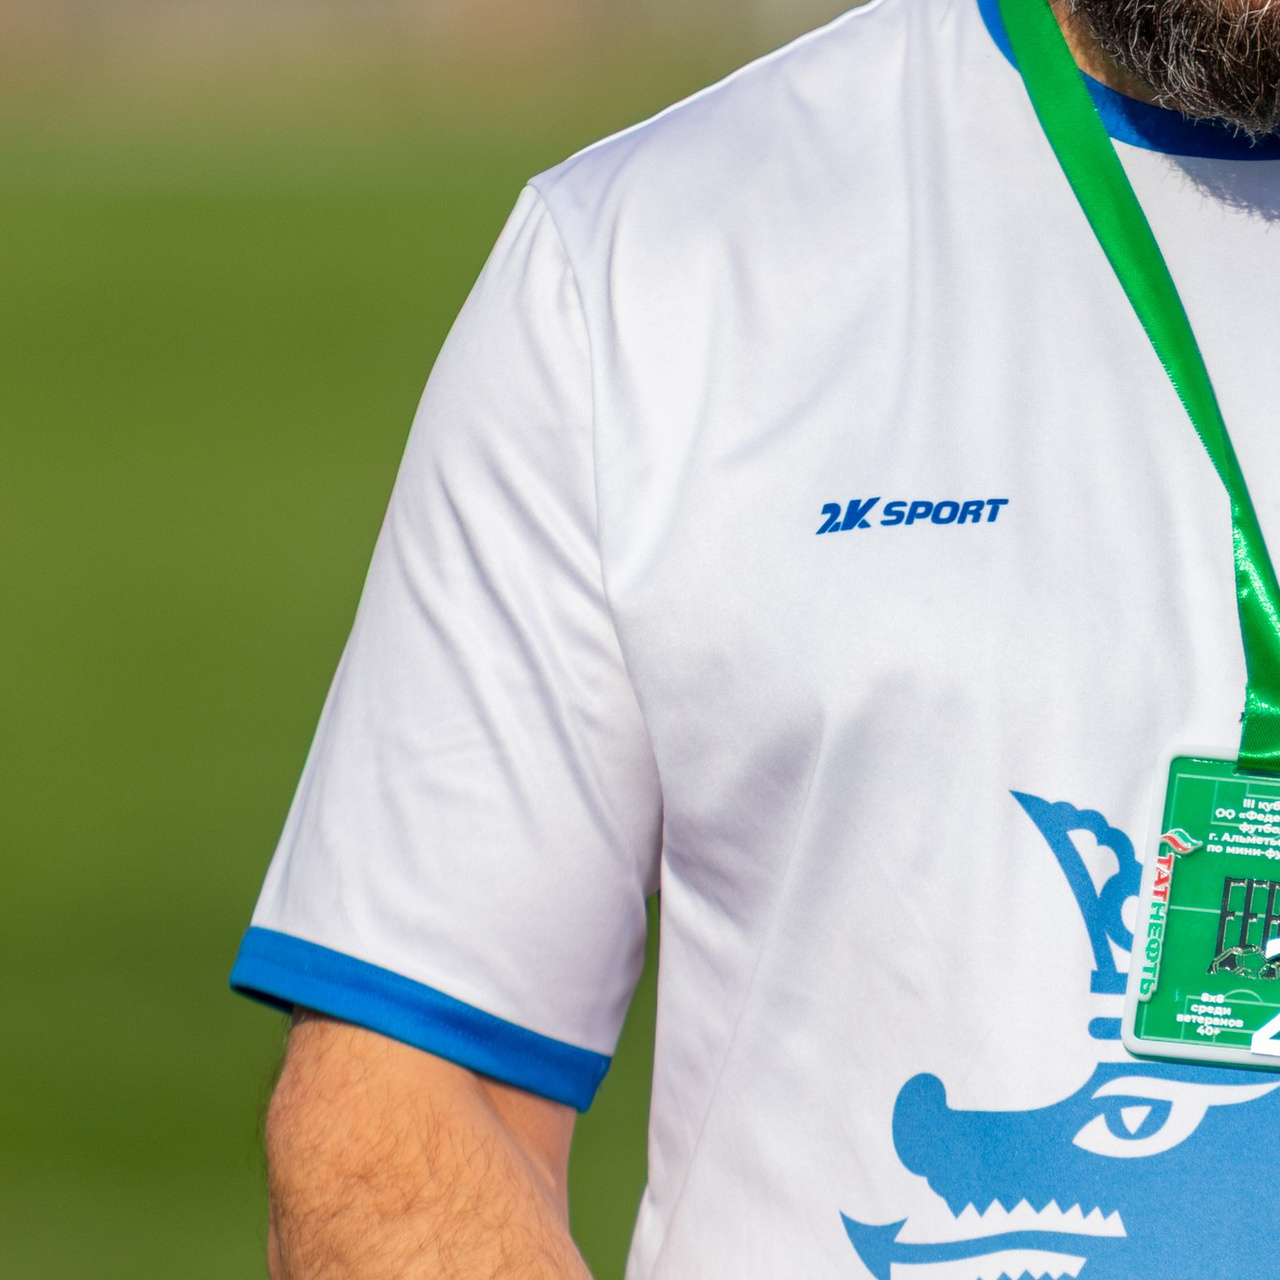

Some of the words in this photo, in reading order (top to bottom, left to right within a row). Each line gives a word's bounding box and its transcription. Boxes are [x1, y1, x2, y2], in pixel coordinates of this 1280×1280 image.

[815, 497, 881, 535] 2K
[880, 498, 1009, 526] SPORT
[1206, 844, 1223, 853] по
[1140, 854, 1174, 996] ТАТНЕФТЬ
[1190, 1004, 1232, 1016] среди
[1176, 1013, 1244, 1028] ветеранов
[1196, 1025, 1221, 1036] 40+
